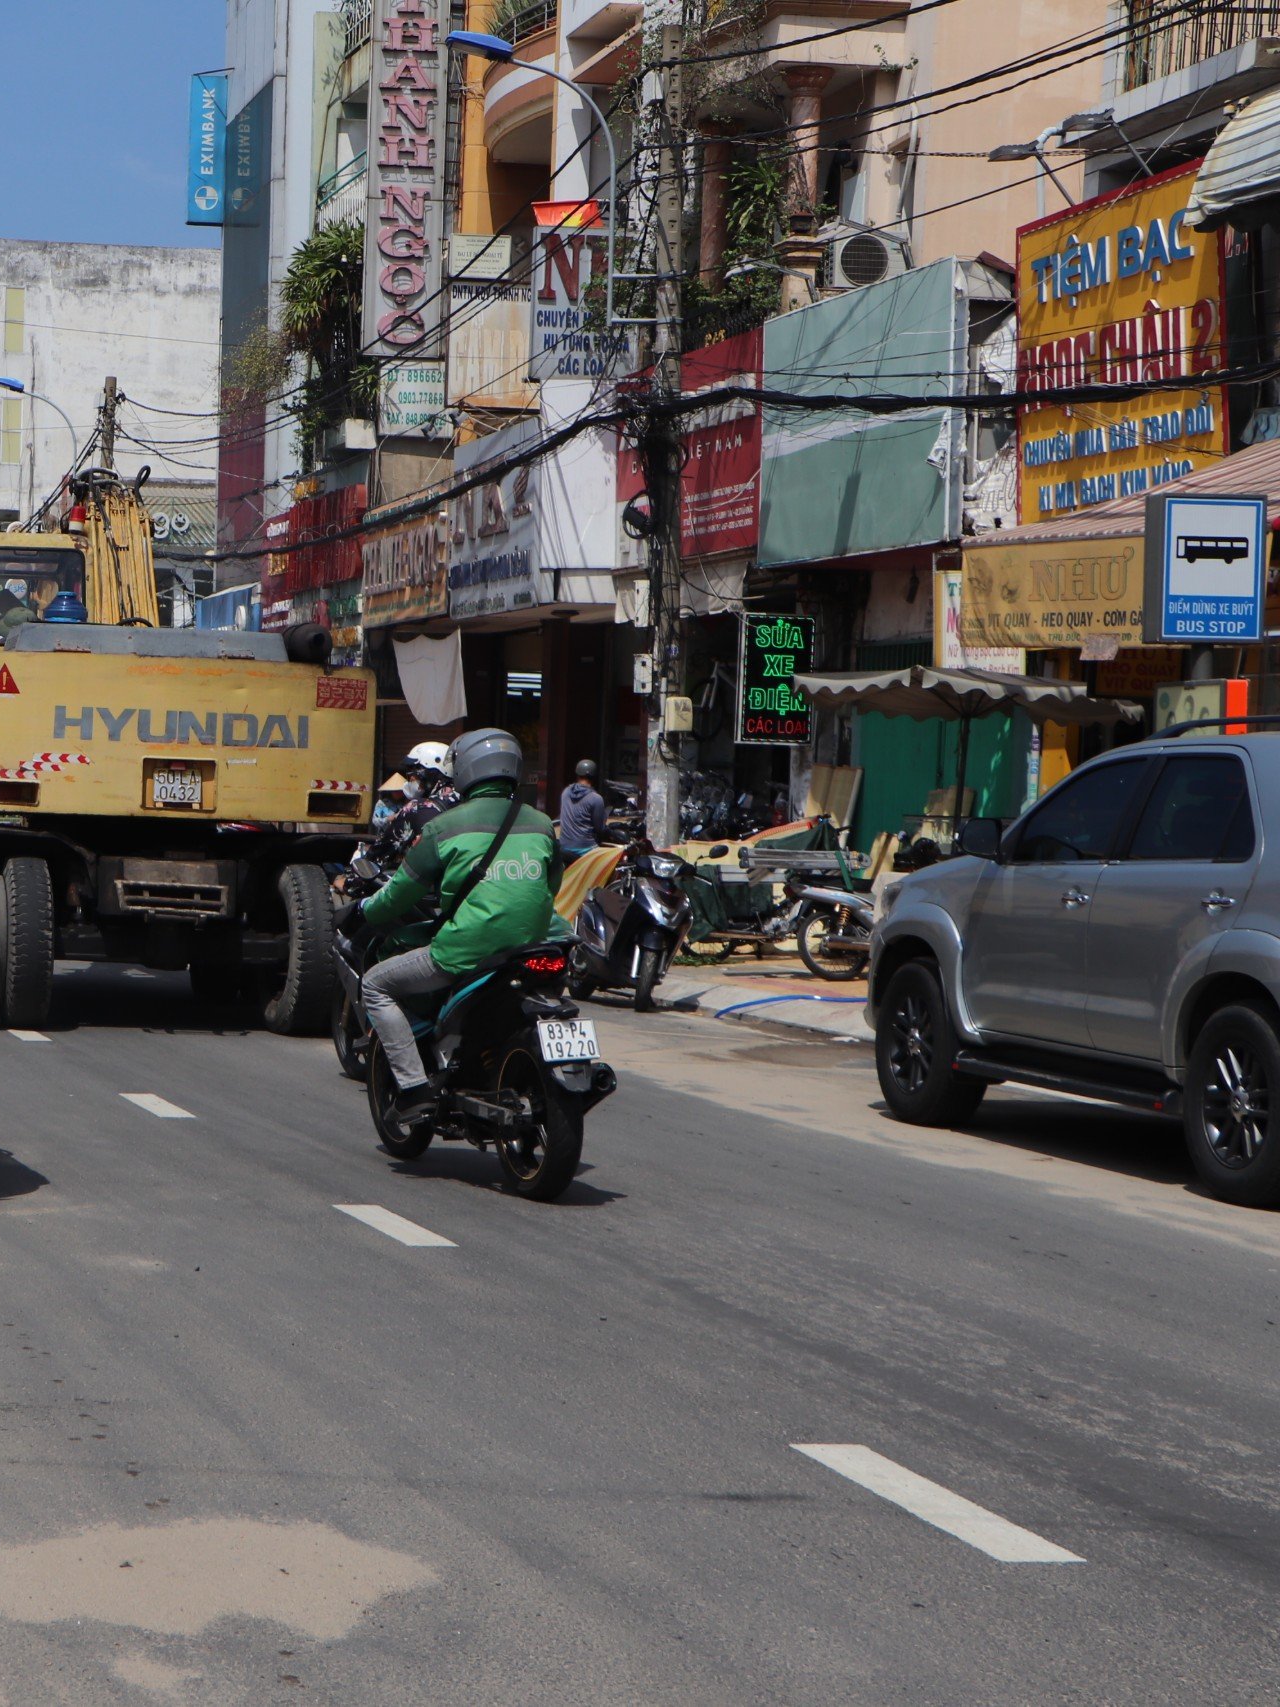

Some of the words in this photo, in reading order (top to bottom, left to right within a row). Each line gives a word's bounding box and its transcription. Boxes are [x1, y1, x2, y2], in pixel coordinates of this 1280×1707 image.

[201, 88, 215, 175] EXIMBANK
[1031, 234, 1110, 307] TIỆM
[1118, 209, 1195, 283] BẠC
[537, 308, 579, 328] CHUYÊN
[1100, 299, 1187, 385] CHÂU
[1192, 299, 1218, 374] 2
[558, 357, 579, 375] CÁC
[716, 434, 742, 451] NAM
[1024, 429, 1072, 468] CHUYÊN
[1075, 427, 1107, 459] MUA
[1110, 416, 1139, 452] BÁN
[1142, 410, 1182, 444] TRAO
[1039, 485, 1053, 512] XI
[1121, 467, 1149, 496] KIM
[1028, 546, 1134, 601] NHƯ
[1169, 598, 1190, 614] ĐIỂM
[1192, 599, 1216, 615] DỪNG
[1219, 603, 1229, 615] XE
[1232, 602, 1254, 616] BUÝT
[1004, 612, 1031, 629] QUAY
[1041, 612, 1063, 628] HEO
[1066, 611, 1093, 629] QUAY
[1177, 620, 1204, 633] BUS
[1209, 620, 1246, 633] STOP
[756, 619, 804, 648] SỬA
[763, 654, 795, 676] XE
[749, 684, 806, 715] ĐIỆN
[54, 705, 309, 748] HYUNDAI
[746, 716, 773, 733] CÁC
[160, 785, 196, 801] 0432
[547, 1022, 586, 1040] 83-P4
[546, 1040, 596, 1059] 192.20
